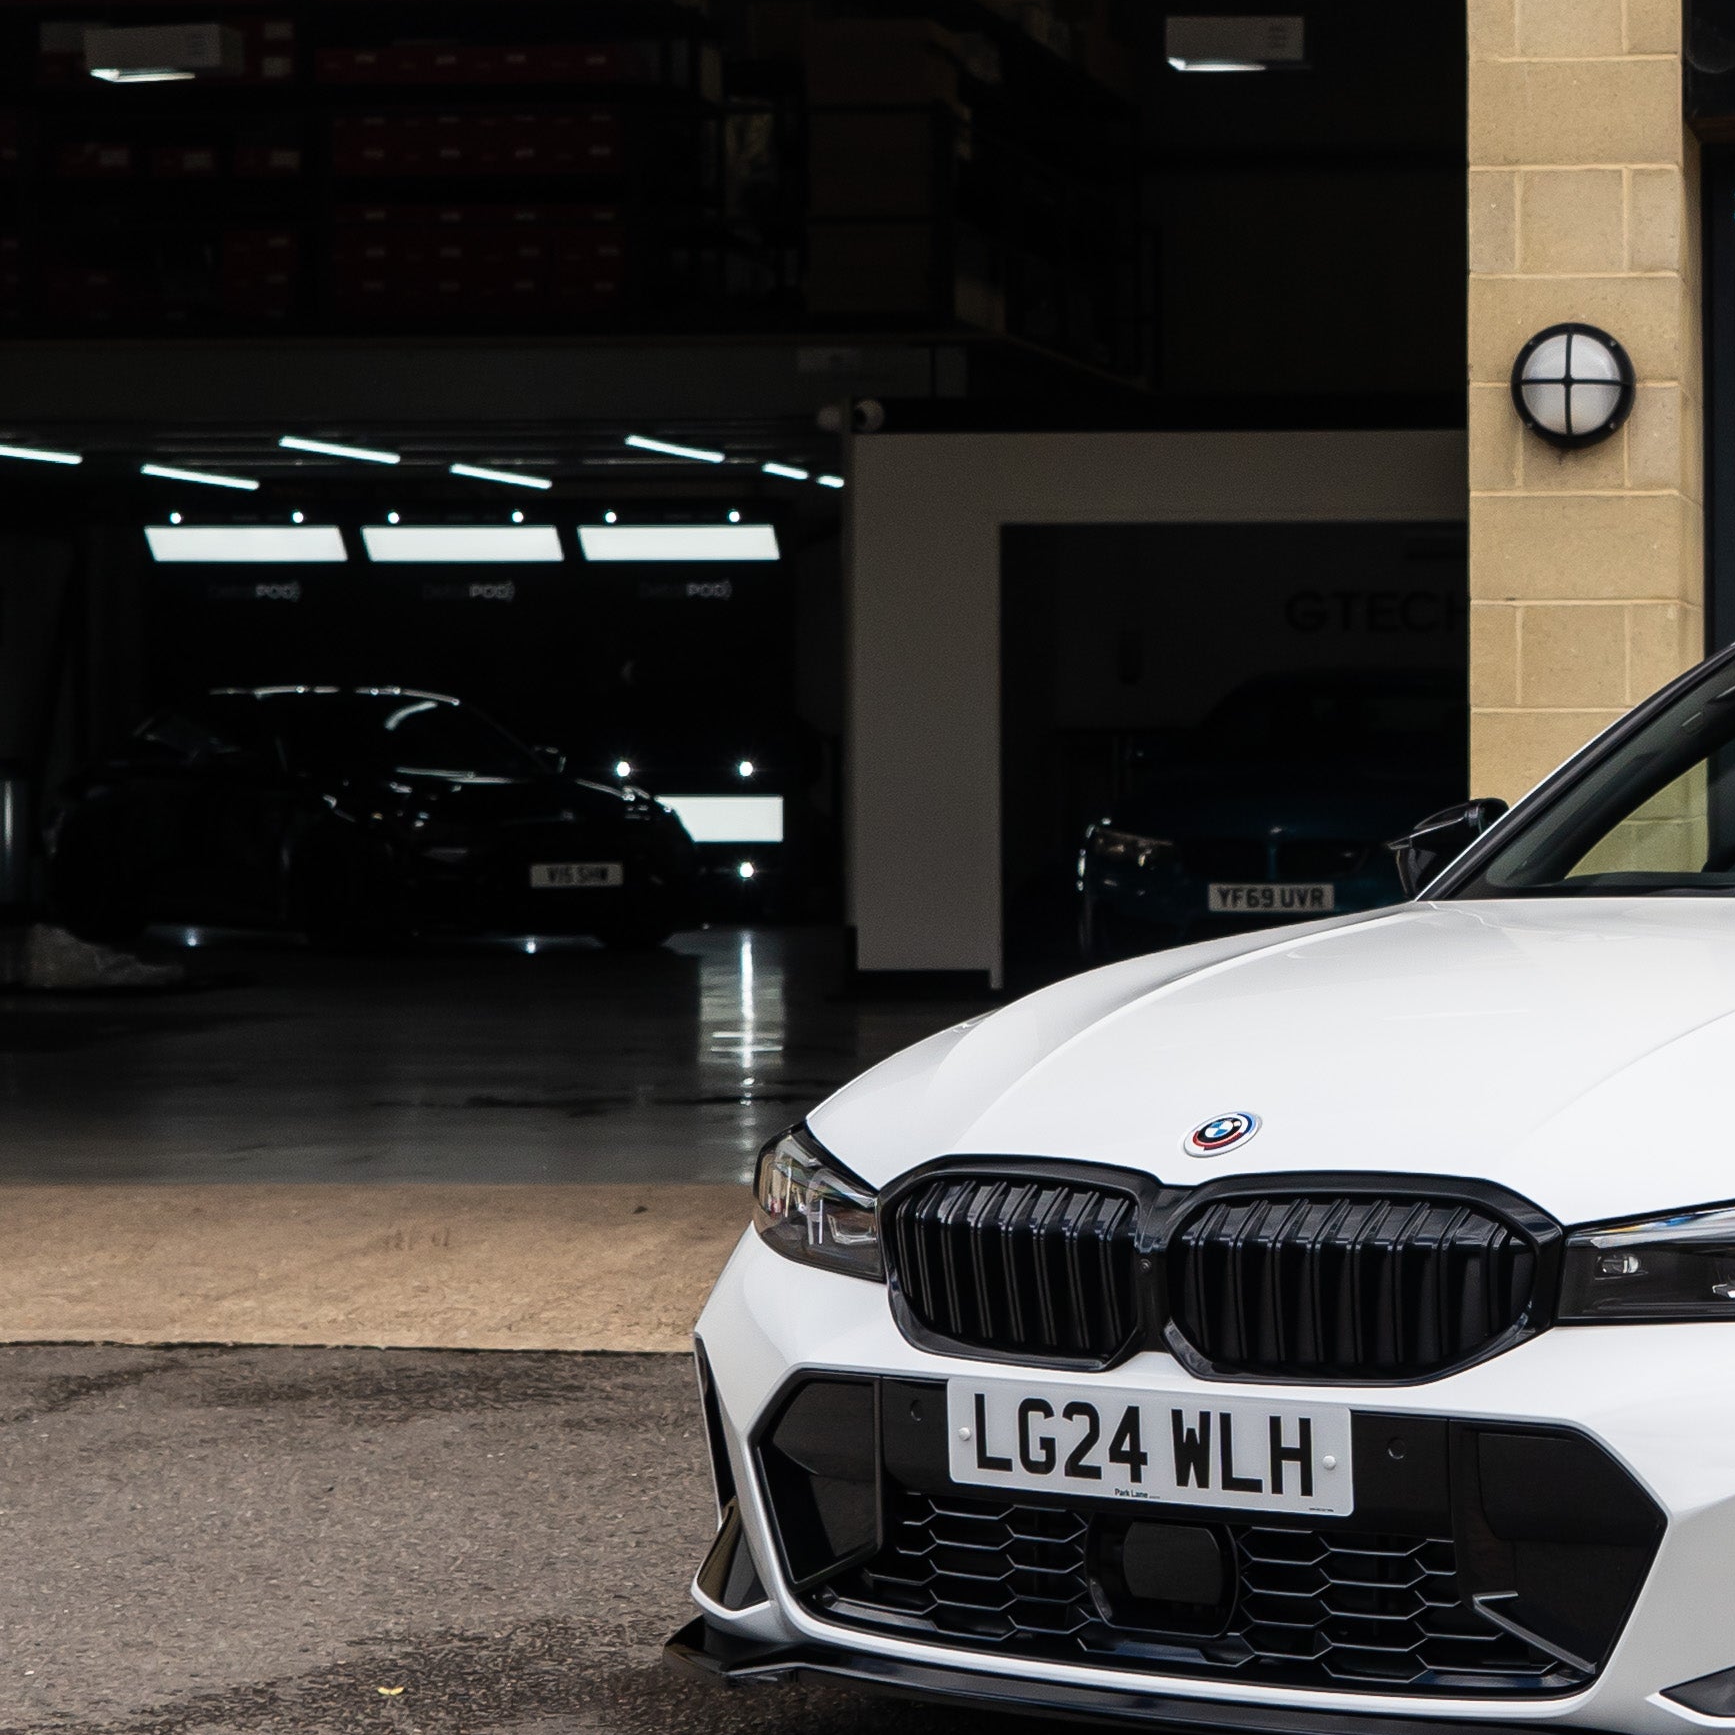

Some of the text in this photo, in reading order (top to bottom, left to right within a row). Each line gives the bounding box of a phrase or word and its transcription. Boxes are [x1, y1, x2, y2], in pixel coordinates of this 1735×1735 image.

[1217, 887, 1324, 908] YF69 UVR
[974, 1393, 1314, 1498] LG24 WLH
[1114, 1487, 1130, 1497] Park
[1131, 1488, 1148, 1499] Lane
